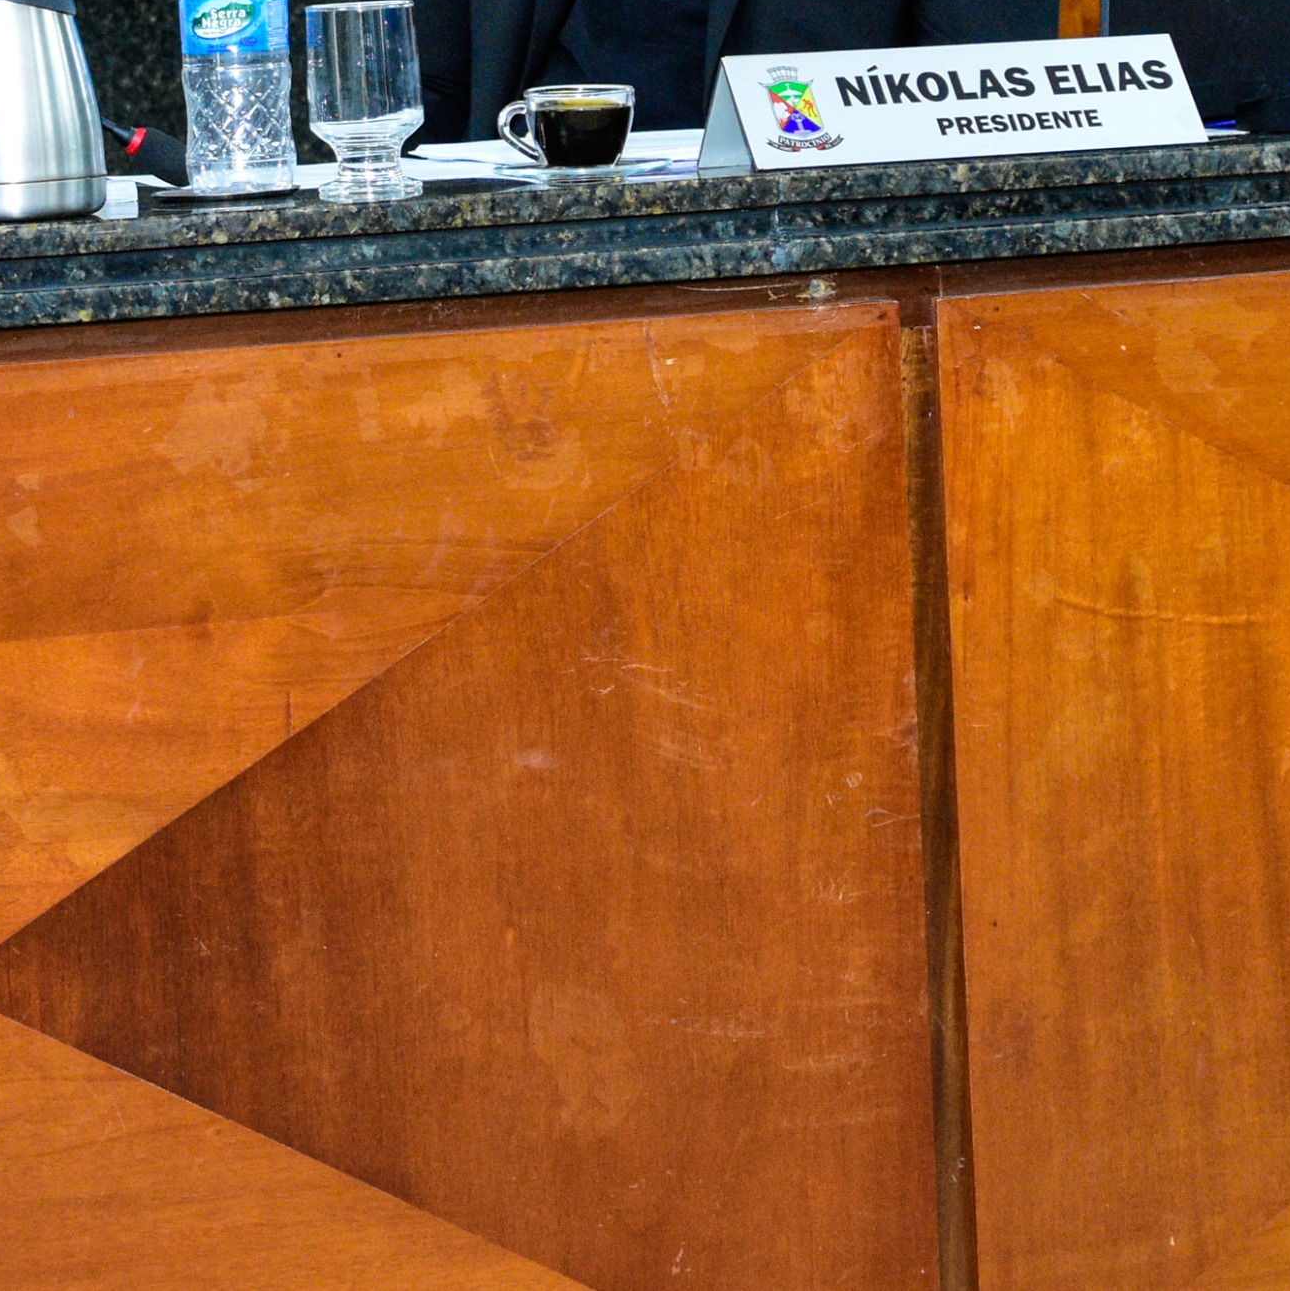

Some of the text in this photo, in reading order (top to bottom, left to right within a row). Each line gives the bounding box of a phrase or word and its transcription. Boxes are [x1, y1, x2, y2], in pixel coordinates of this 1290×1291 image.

[202, 17, 242, 31] Negra
[210, 8, 246, 19] Serra
[835, 59, 1174, 107] NÍKOLAS ELIAS
[936, 109, 1103, 137] PRESIDENTE
